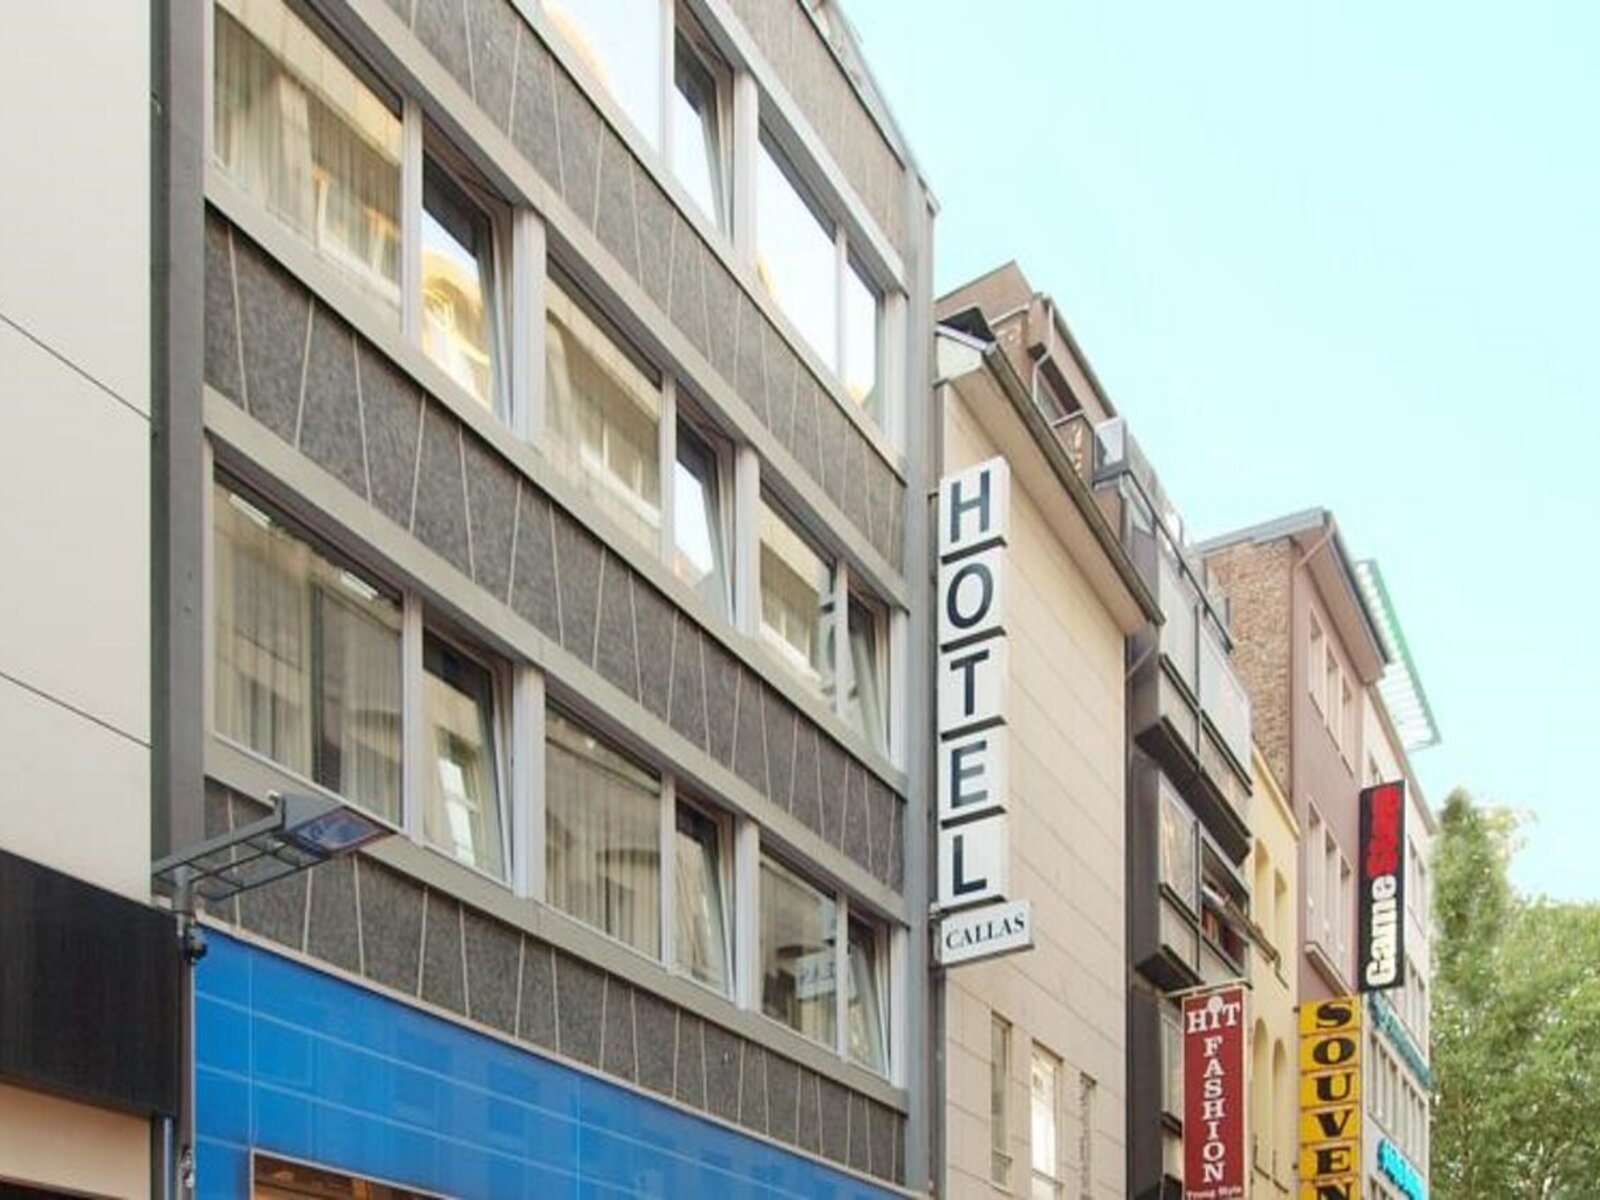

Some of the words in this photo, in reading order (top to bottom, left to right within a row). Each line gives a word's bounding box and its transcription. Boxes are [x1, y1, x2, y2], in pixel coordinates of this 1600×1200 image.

[946, 470, 994, 896] HOTEL
[945, 913, 1025, 949] CALLAS
[1187, 996, 1241, 1034] HIT
[1202, 1035, 1226, 1183] FASHION
